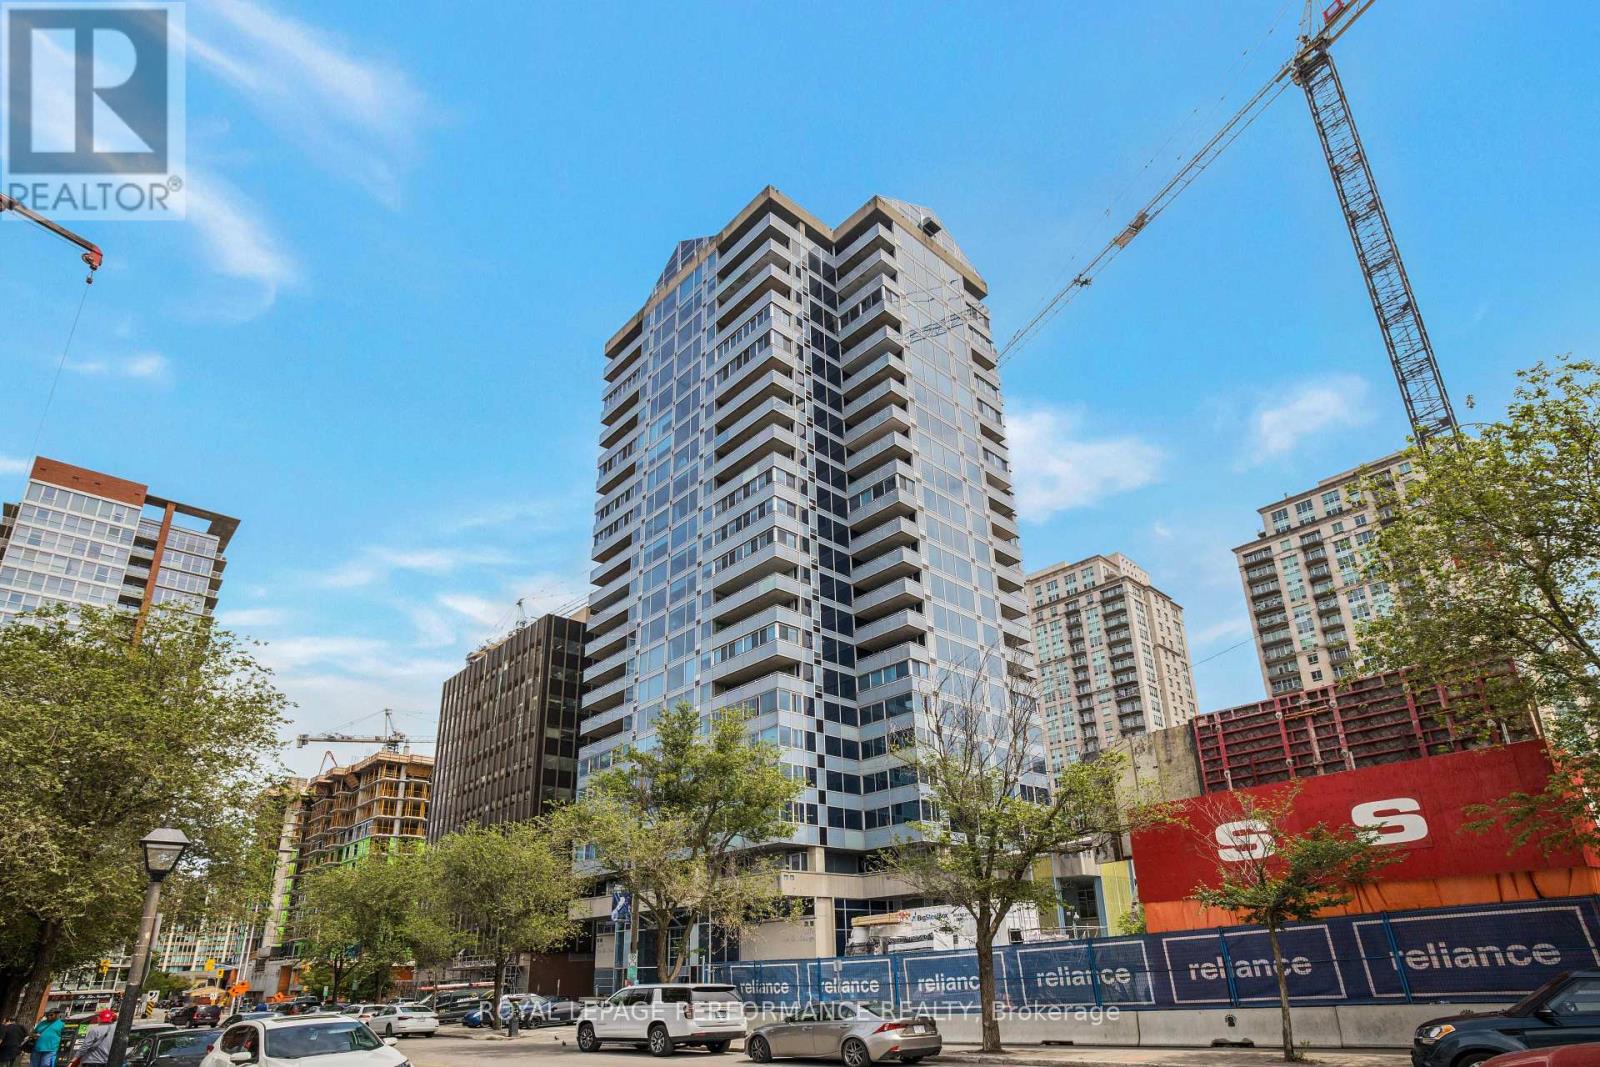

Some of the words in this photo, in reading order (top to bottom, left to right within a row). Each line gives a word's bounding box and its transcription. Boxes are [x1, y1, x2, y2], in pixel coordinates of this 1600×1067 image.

[1036, 966, 1131, 988] reliance
[1188, 956, 1313, 981] relance
[740, 979, 790, 995] reliance
[918, 972, 981, 993] relianc
